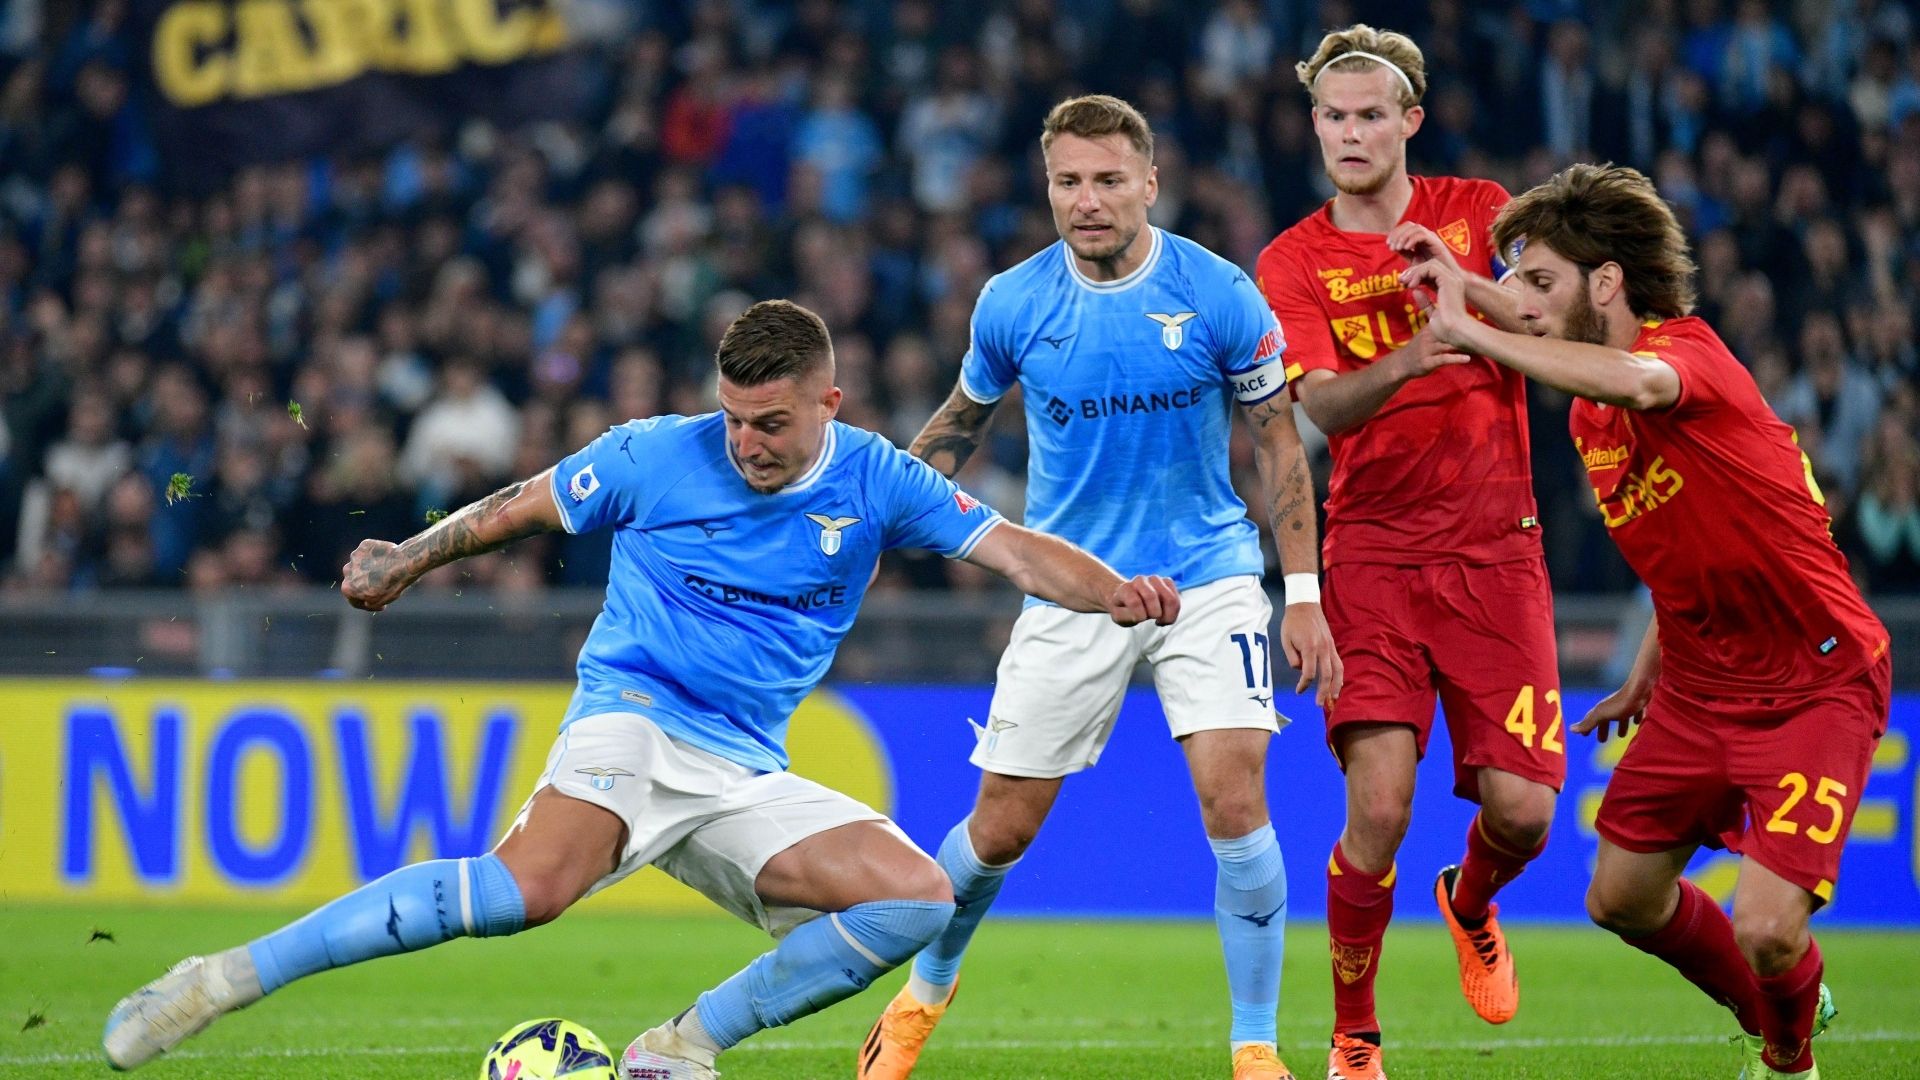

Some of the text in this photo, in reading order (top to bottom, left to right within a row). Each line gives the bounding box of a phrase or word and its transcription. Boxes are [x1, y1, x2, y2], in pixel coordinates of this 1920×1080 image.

[1081, 385, 1202, 419] BINANCE
[1230, 631, 1268, 688] 17
[1504, 685, 1563, 755] 42
[62, 706, 519, 885] NOW
[1765, 772, 1847, 844] 25
